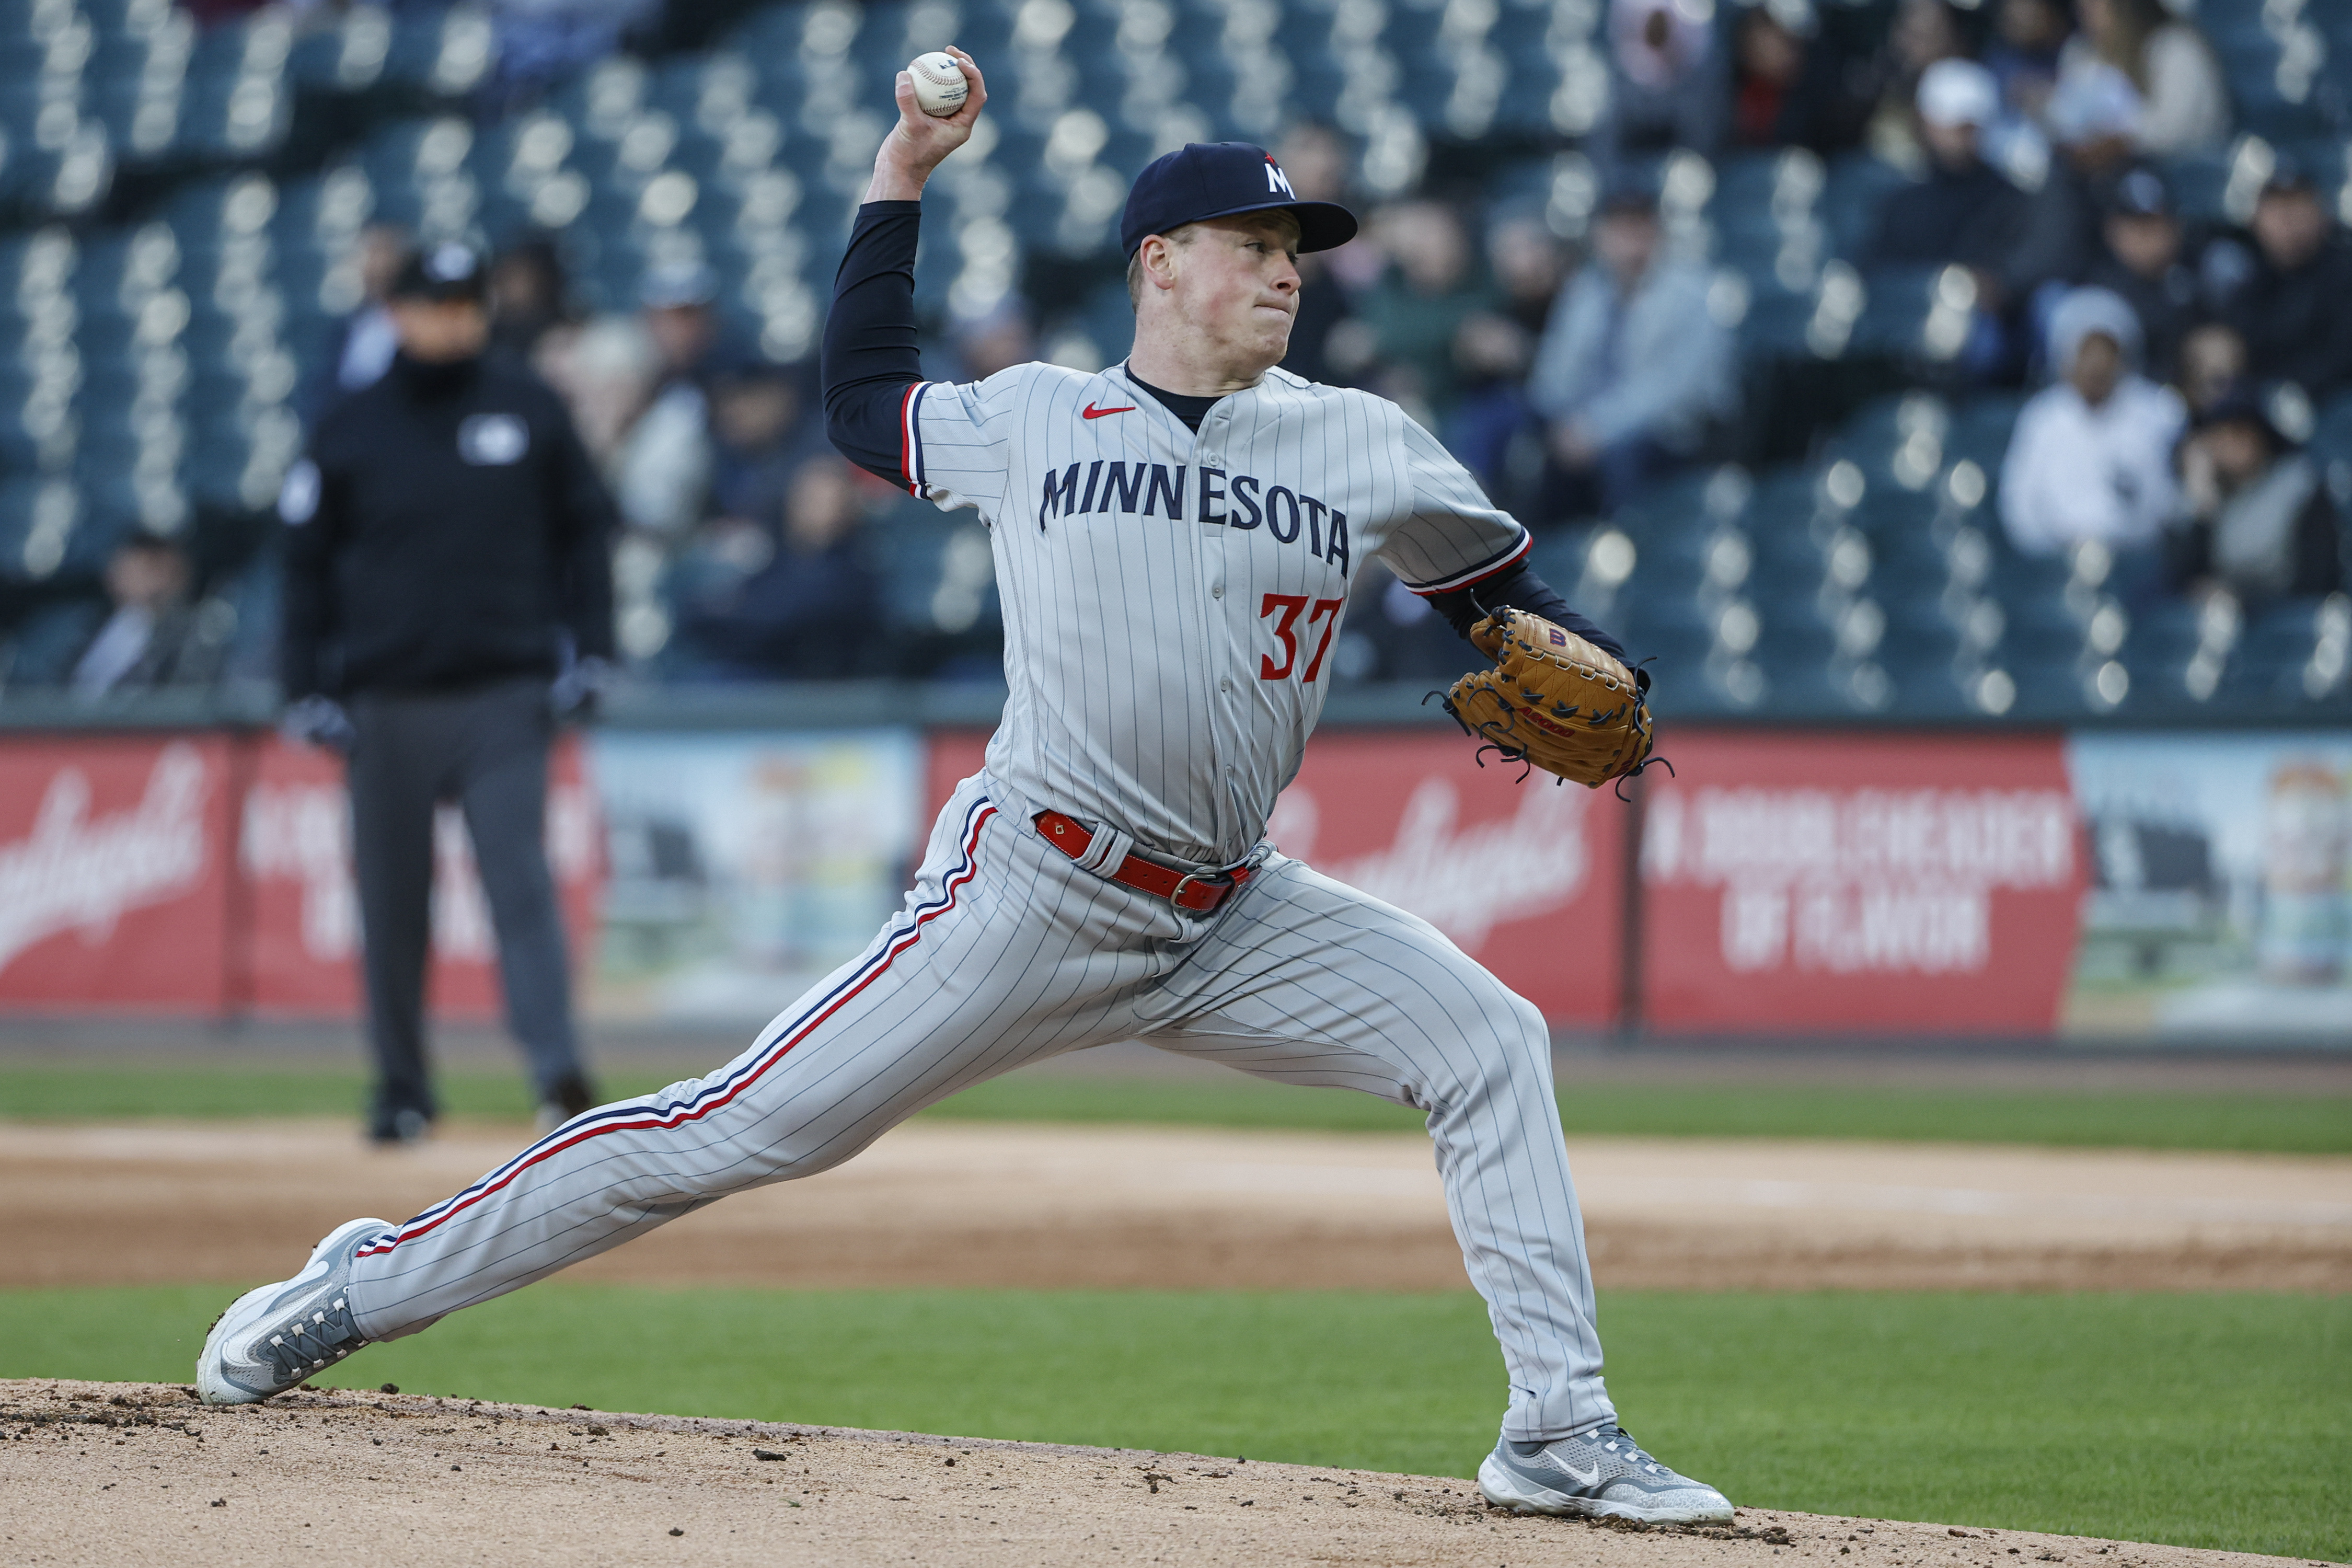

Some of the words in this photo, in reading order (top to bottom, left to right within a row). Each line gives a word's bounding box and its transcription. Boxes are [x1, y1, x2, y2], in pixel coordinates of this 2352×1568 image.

[1264, 163, 1296, 201] M
[1040, 459, 1350, 580] MINNESOTA
[1260, 593, 1344, 683] 37
